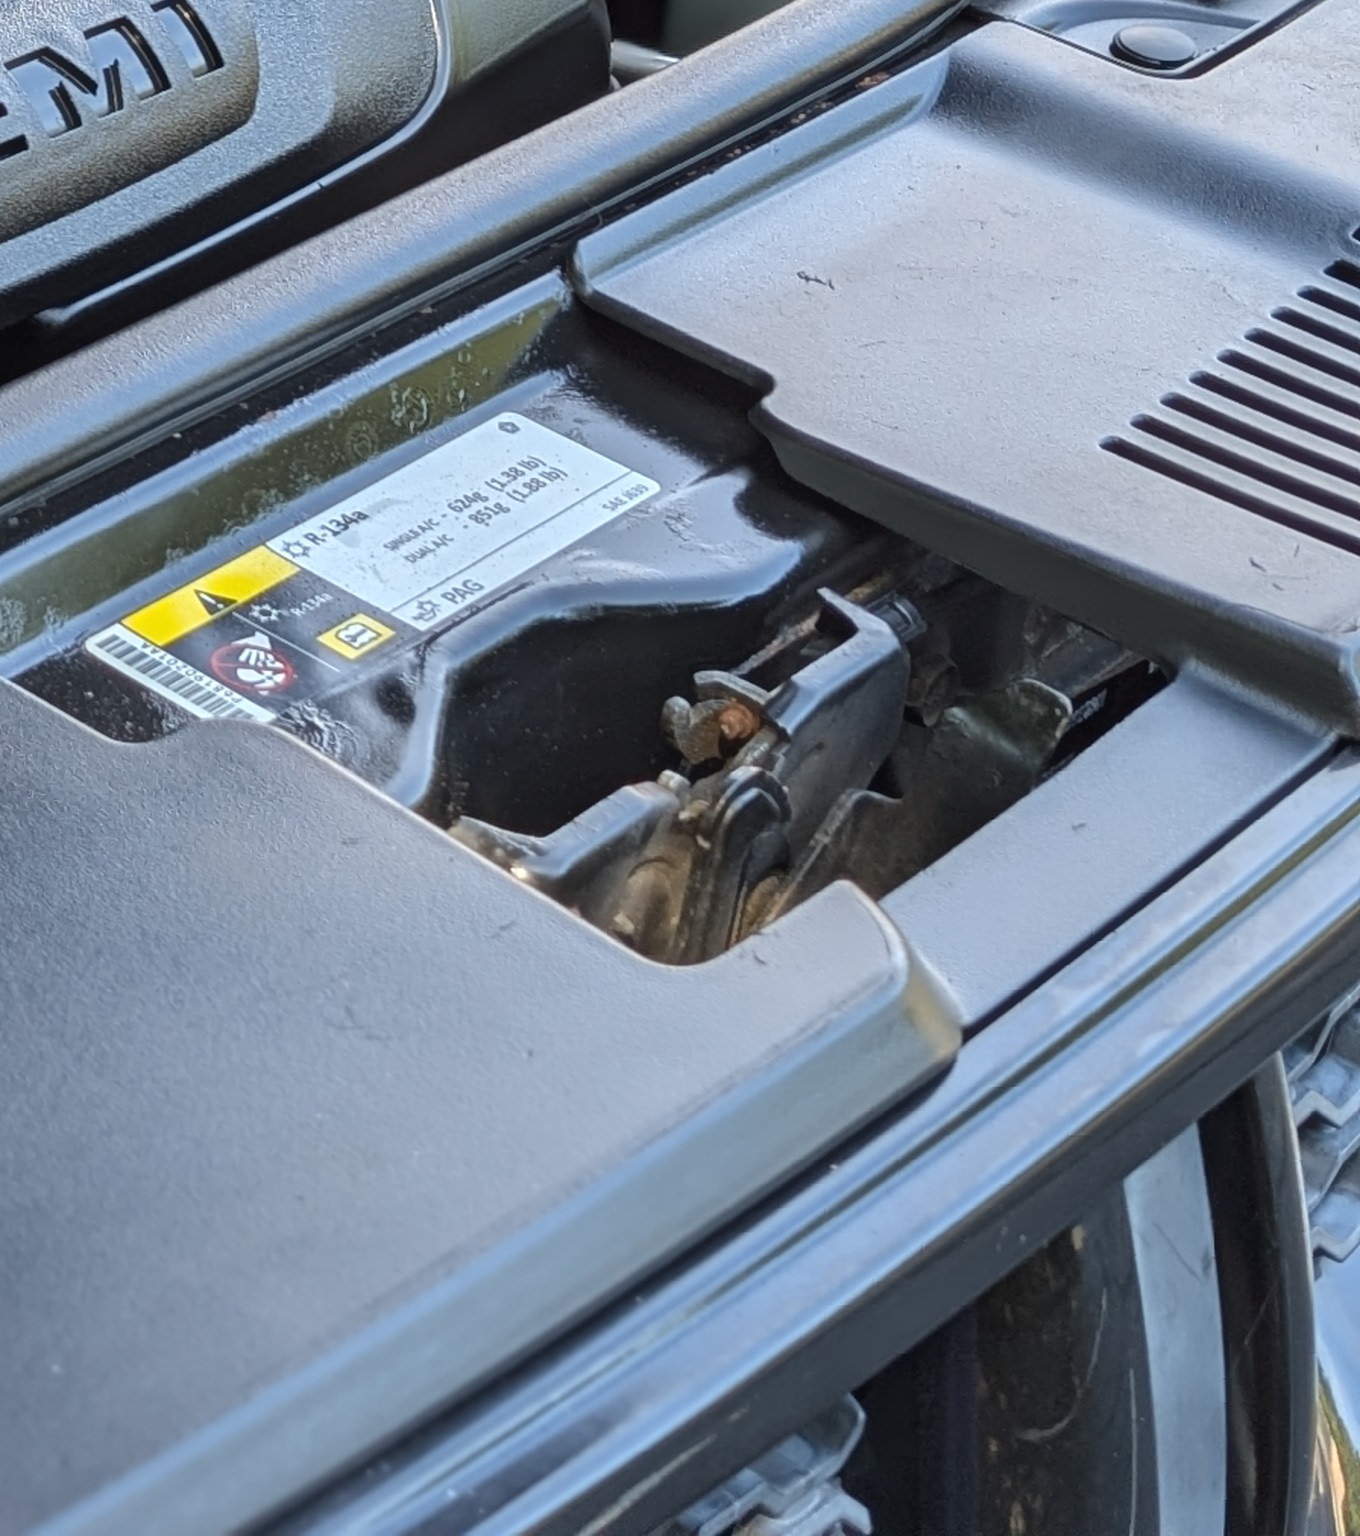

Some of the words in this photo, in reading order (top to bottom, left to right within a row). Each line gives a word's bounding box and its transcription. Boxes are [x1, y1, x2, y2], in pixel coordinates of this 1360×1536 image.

[383, 529, 421, 551] SINGLE
[417, 518, 440, 534] A/C
[447, 491, 490, 513] 624g
[484, 466, 526, 493] (1.38
[516, 454, 548, 471] lb)
[403, 545, 436, 564] DUAL
[431, 534, 455, 549] A/C
[468, 502, 511, 524] 851g
[505, 477, 548, 503] (1.88
[537, 465, 570, 482] lb)
[601, 496, 628, 512] SAE
[304, 507, 371, 547] R-134a
[290, 592, 333, 617] R-134a
[440, 578, 485, 604] PAG
[140, 641, 243, 704] P68190201AA
